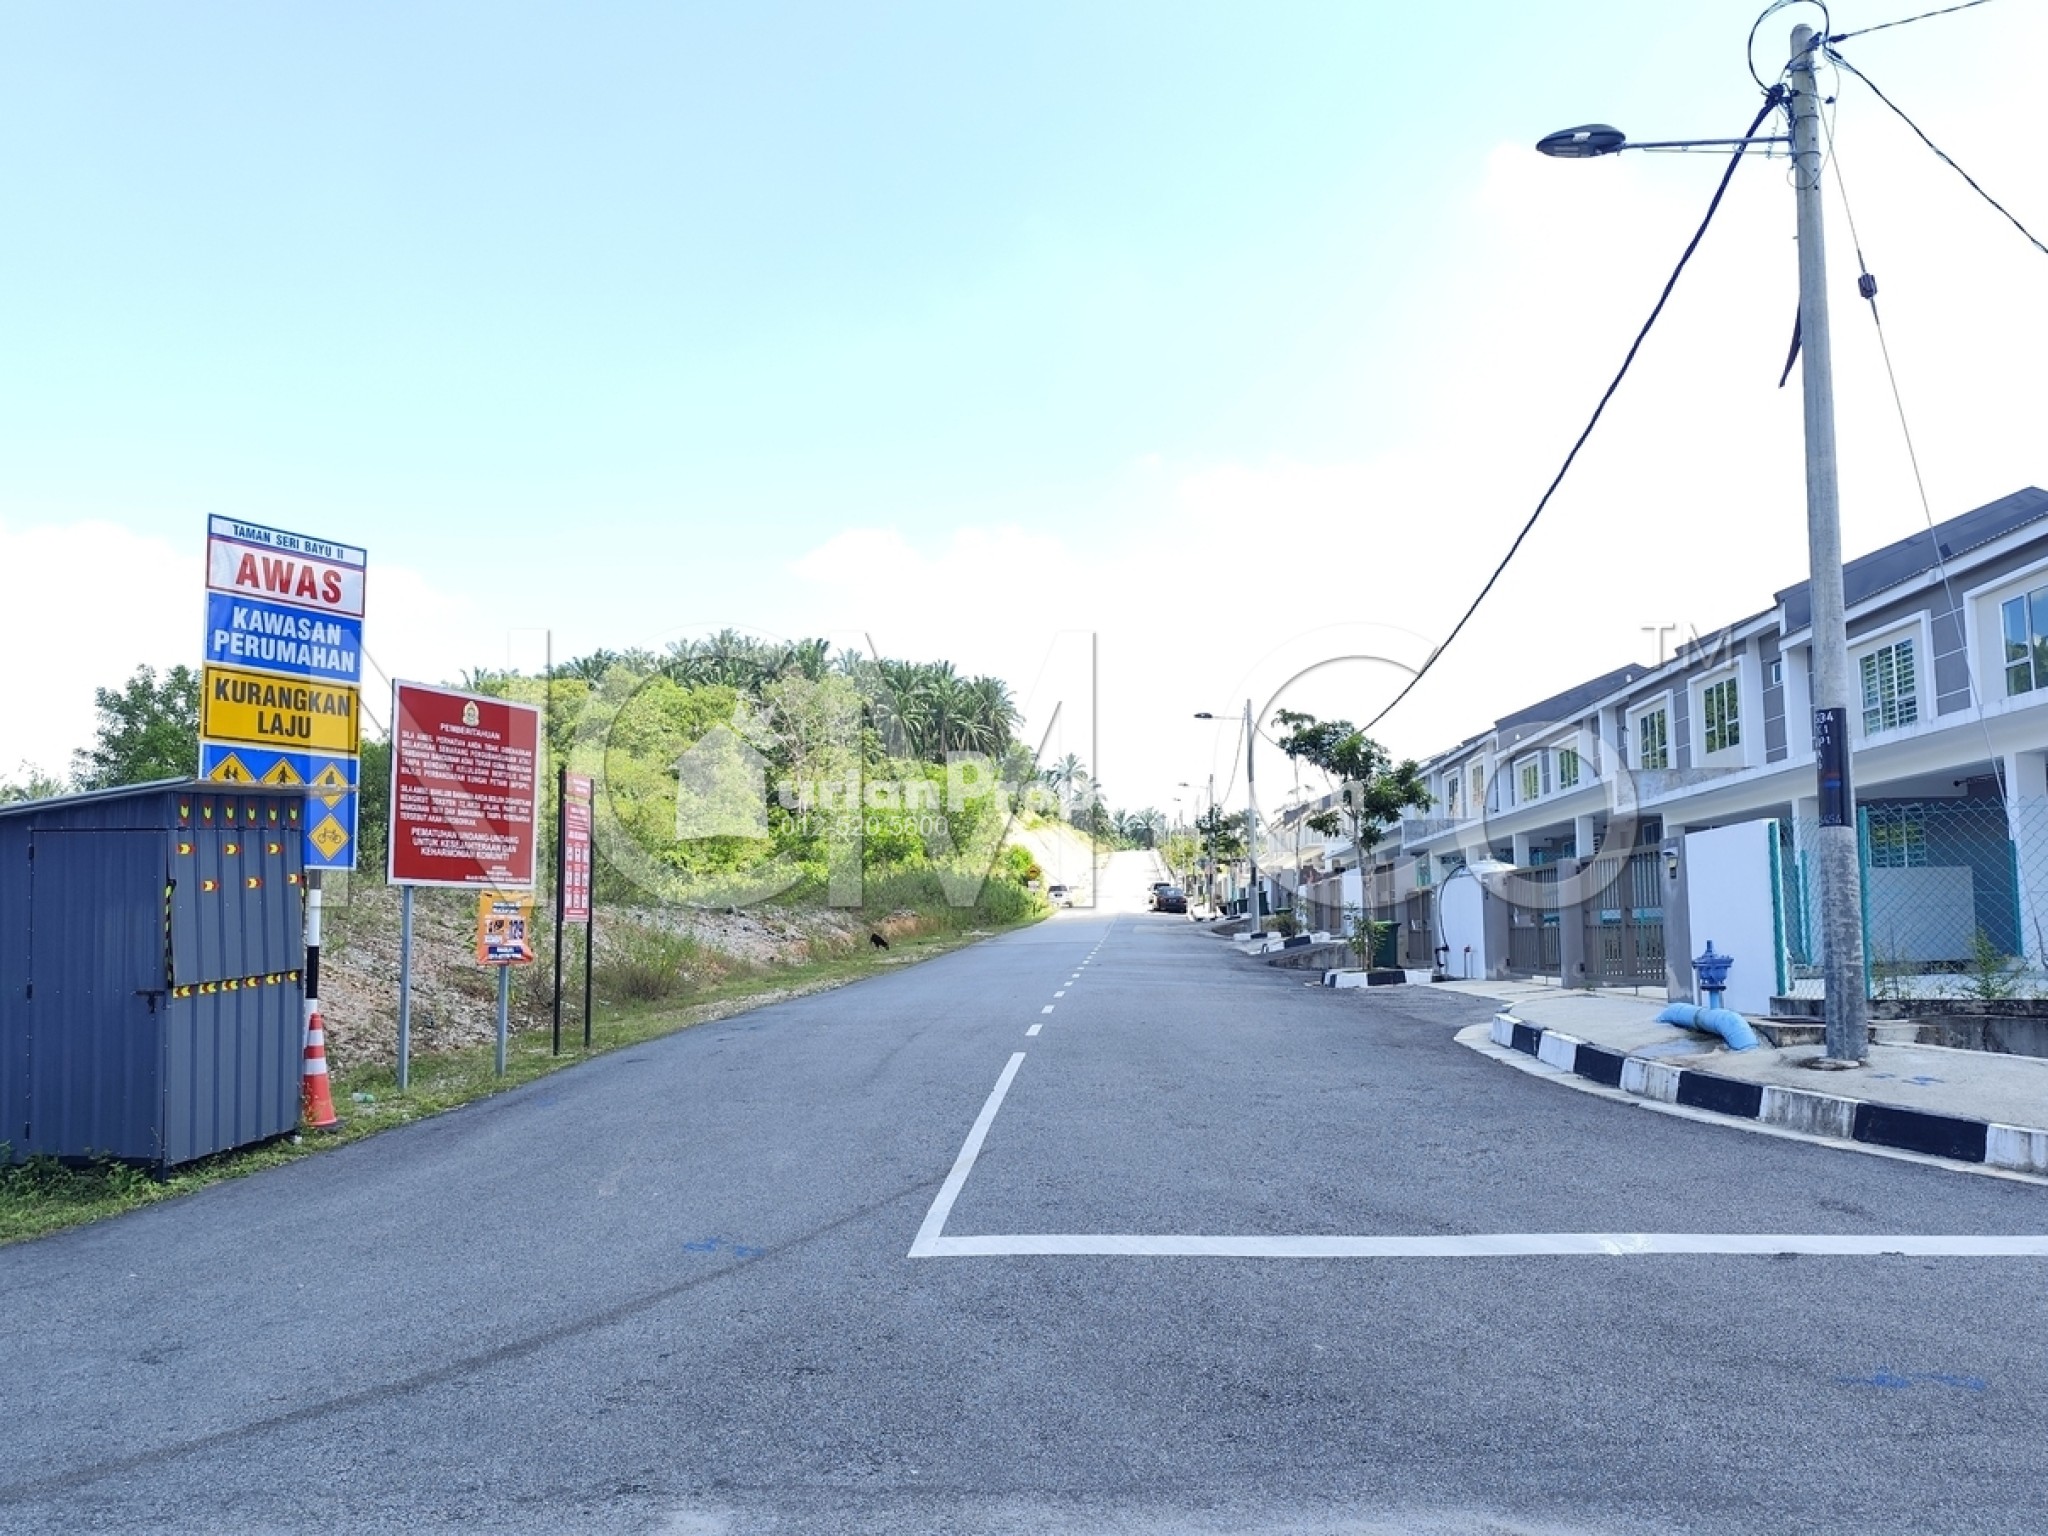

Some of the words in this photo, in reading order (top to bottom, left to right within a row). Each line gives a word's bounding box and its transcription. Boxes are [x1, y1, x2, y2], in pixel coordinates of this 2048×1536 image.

[233, 524, 271, 543] TAMAN
[276, 534, 300, 550] SERI
[305, 541, 332, 557] BAYU
[235, 552, 342, 604] AWAS
[233, 605, 342, 646] KAWASAN
[214, 629, 355, 673] PERUMAHAN
[214, 676, 350, 717] KURANGKAN
[257, 710, 312, 739] LAJU
[440, 723, 500, 739] PEMBERITAHUAN
[411, 827, 457, 839] PEMATUHAN
[412, 837, 438, 847] UNTUK
